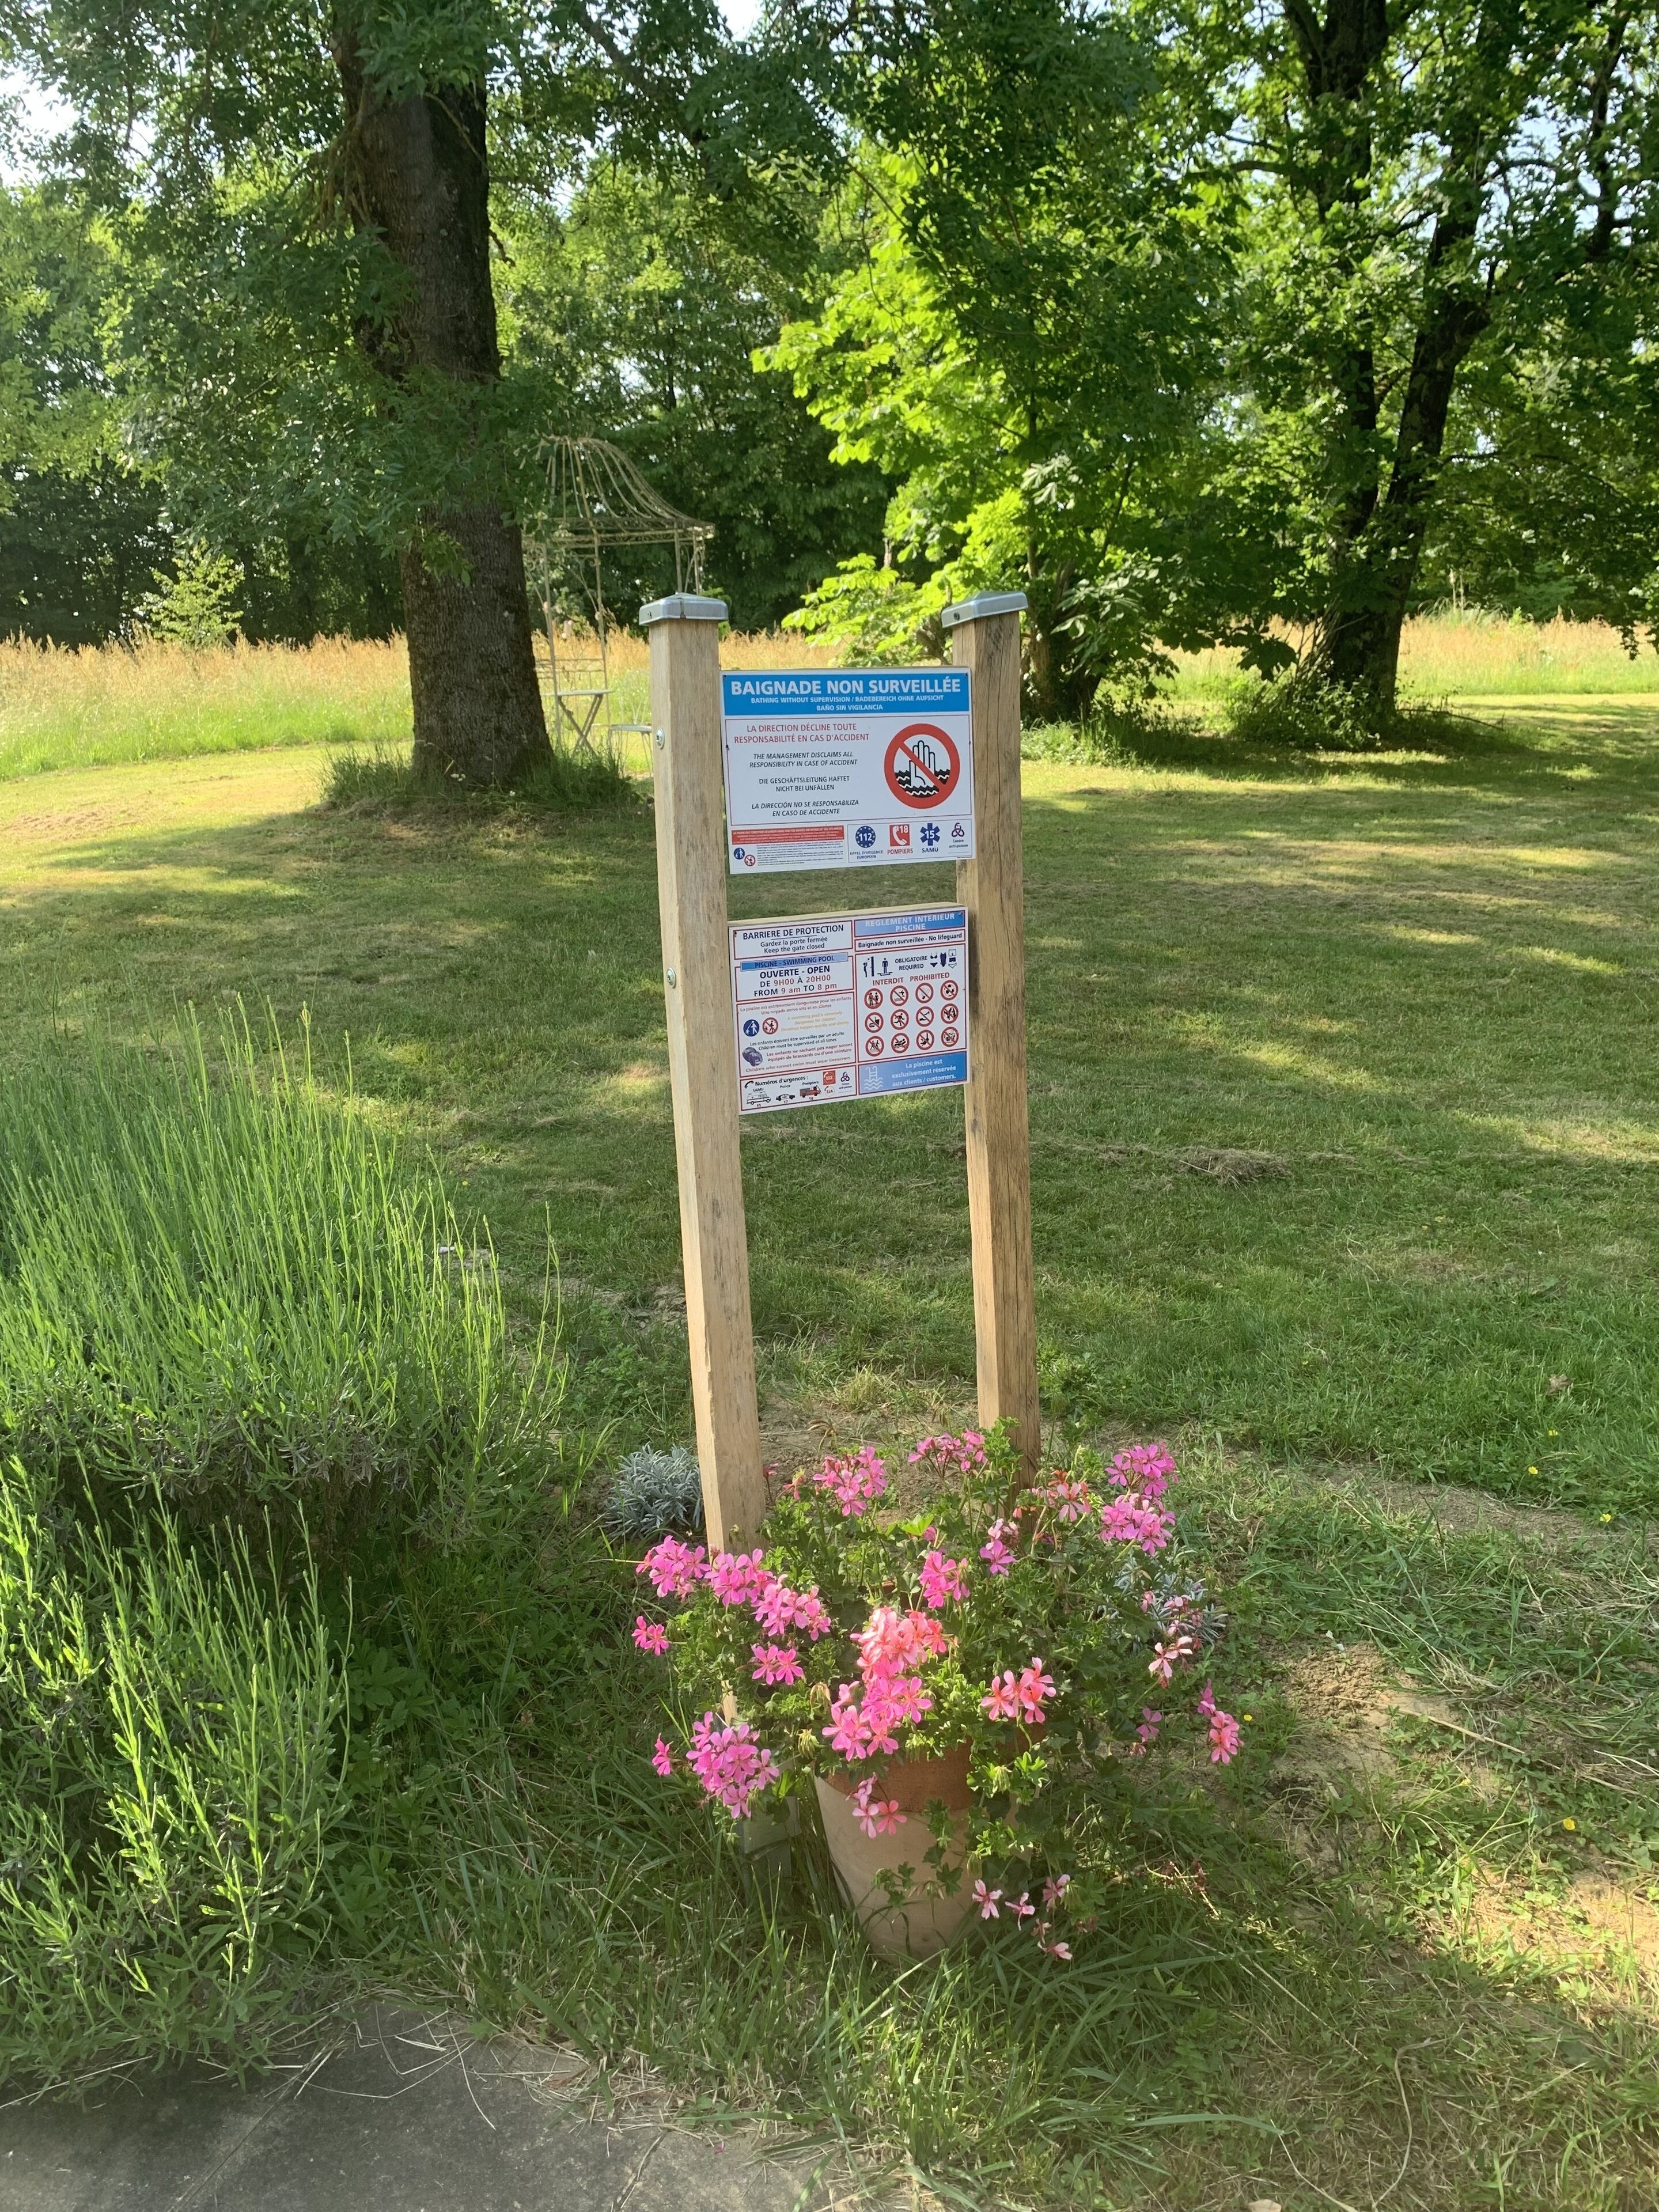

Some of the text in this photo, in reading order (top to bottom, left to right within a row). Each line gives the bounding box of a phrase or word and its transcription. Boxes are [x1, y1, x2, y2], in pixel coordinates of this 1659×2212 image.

[731, 676, 960, 695] BAIGNADE NON SURVEILLÉE
[801, 722, 830, 731] DÉCLINE
[734, 734, 795, 743] RESPONSABILITÉ
[859, 833, 872, 842] 112
[925, 831, 934, 839] 15
[865, 913, 955, 927] REGLEMENT INTERIEUR
[896, 923, 926, 932] PISCINE
[743, 930, 781, 940] BARRIERE
[796, 925, 844, 935] PROTECTION
[755, 960, 777, 968] PISCINE
[783, 957, 816, 965] SWIMMING
[760, 965, 830, 978] OUVERTE OPEN
[806, 975, 831, 983] 20H00
[873, 977, 904, 986] INTERDIT
[910, 972, 950, 982] PROHIBITED
[755, 988, 778, 997] FROM
[825, 983, 837, 991] pm
[892, 1065, 956, 1078] exclusivement réservée
[779, 1075, 805, 1084] d'urgences
